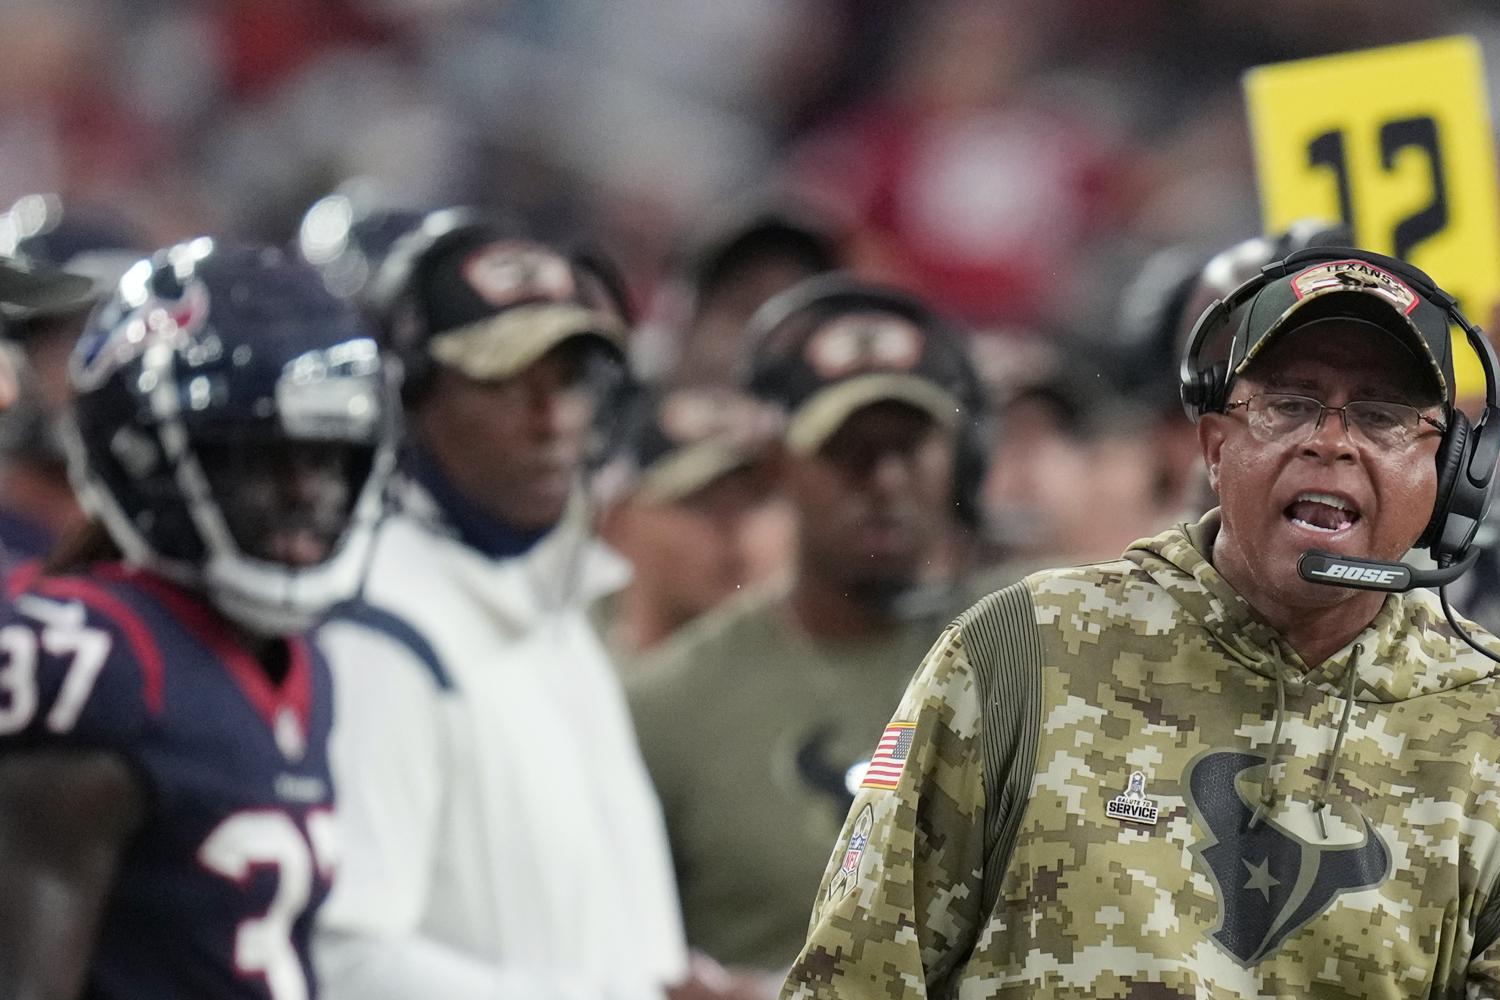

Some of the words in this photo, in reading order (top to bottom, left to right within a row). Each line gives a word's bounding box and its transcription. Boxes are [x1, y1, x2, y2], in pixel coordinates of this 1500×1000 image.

[1307, 117, 1447, 260] 12
[1326, 263, 1393, 284] TEXANS
[1311, 563, 1405, 585] BOSE
[1108, 801, 1157, 820] SERVICE
[1117, 796, 1141, 807] SALUTE
